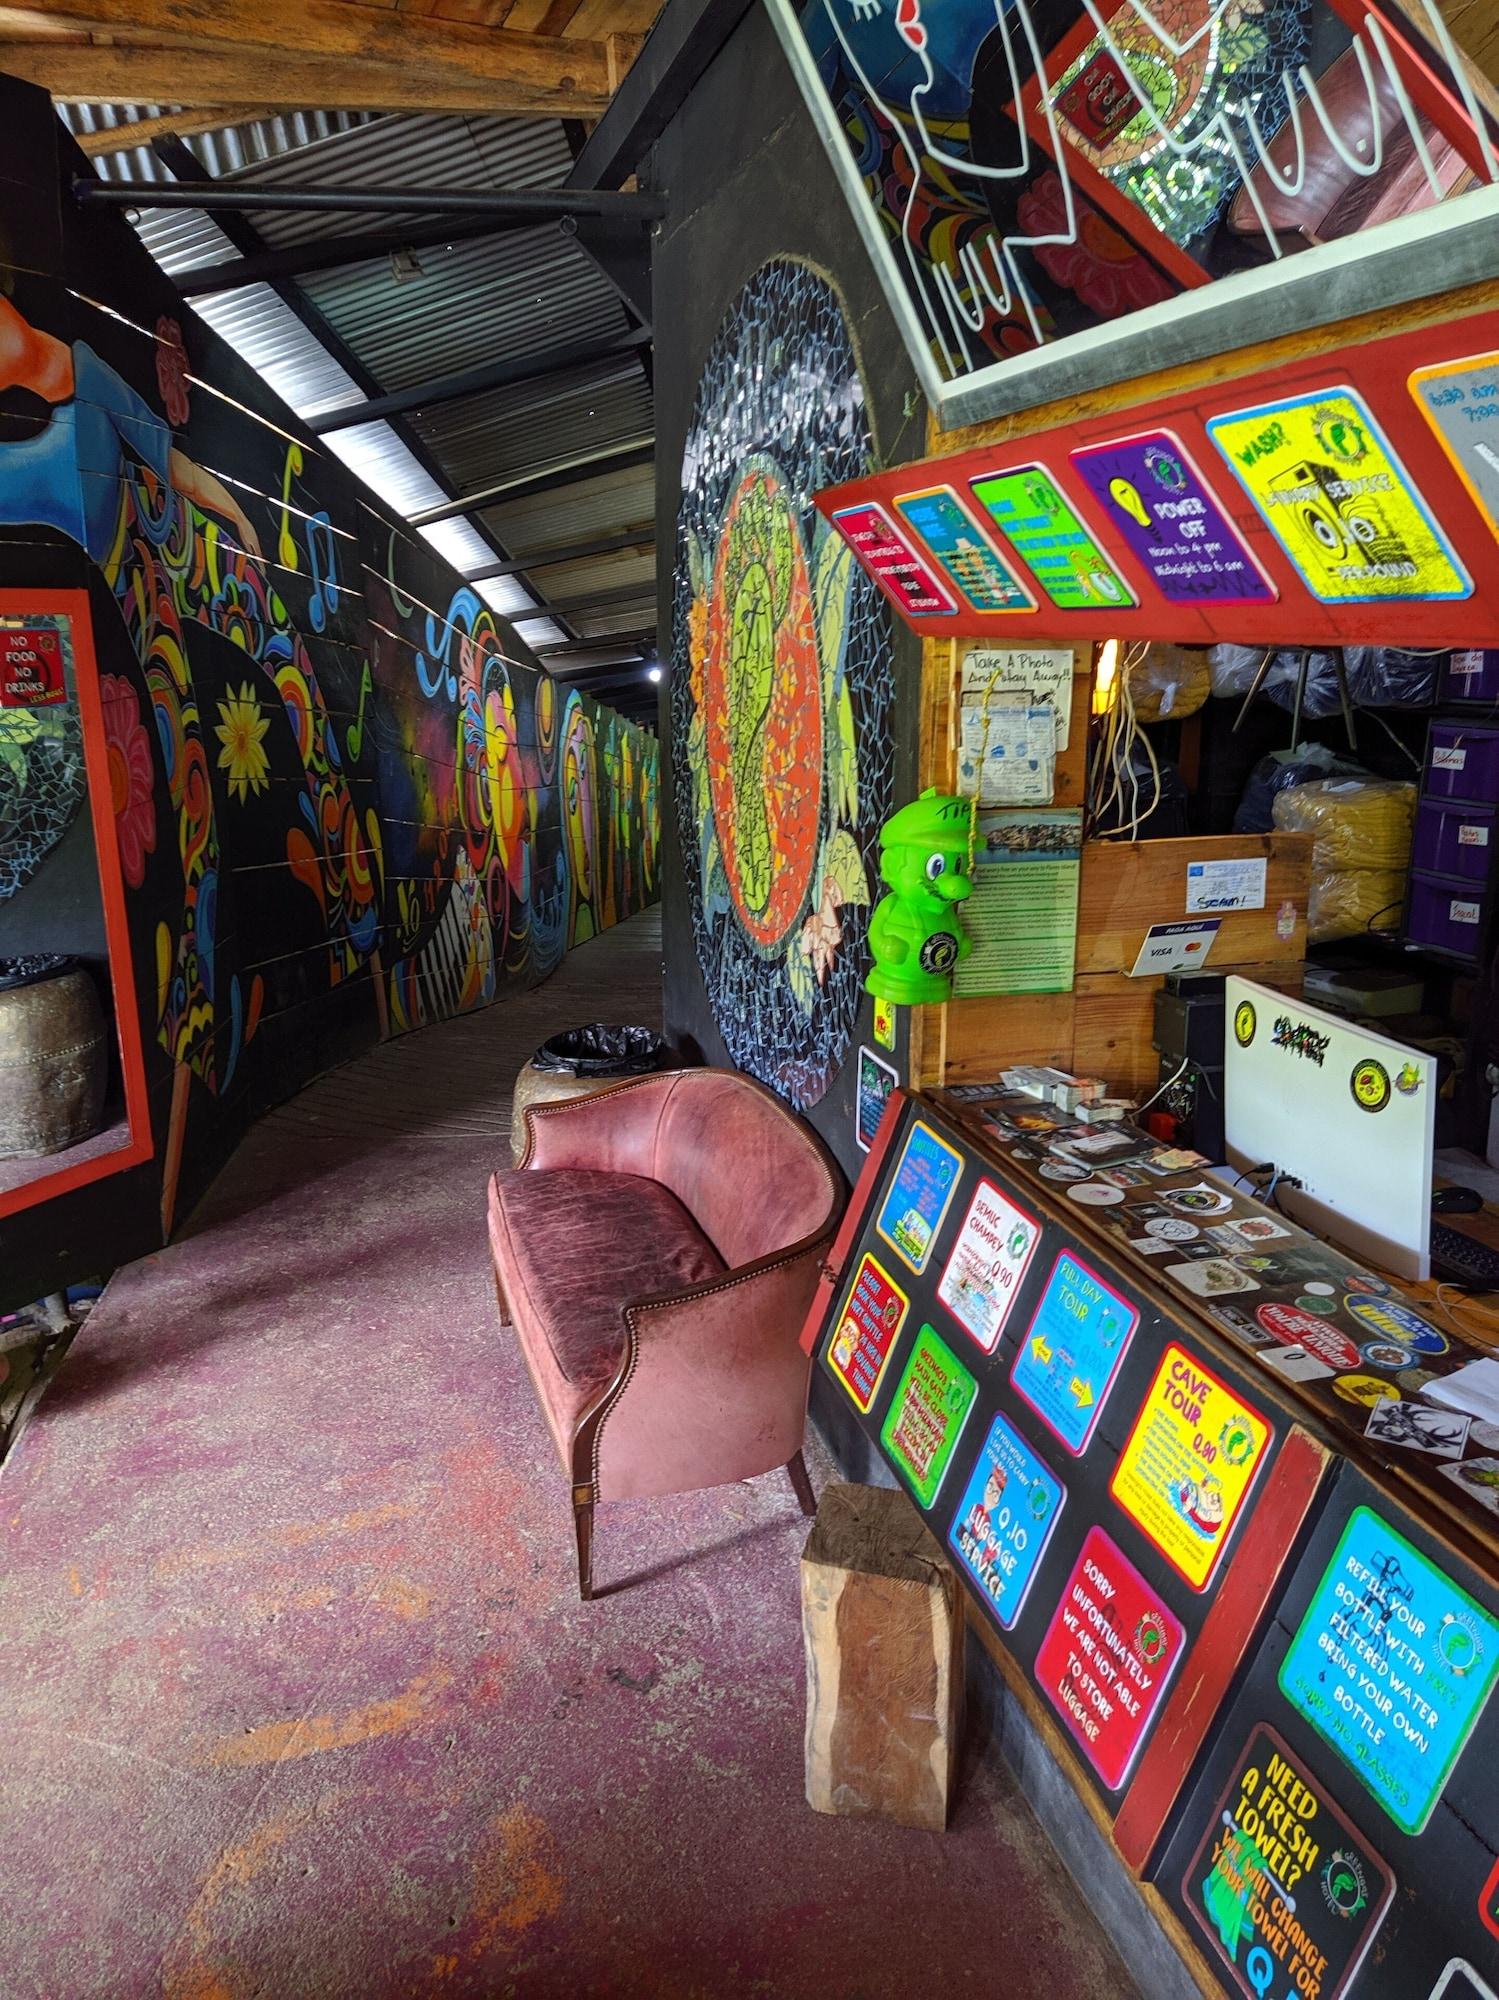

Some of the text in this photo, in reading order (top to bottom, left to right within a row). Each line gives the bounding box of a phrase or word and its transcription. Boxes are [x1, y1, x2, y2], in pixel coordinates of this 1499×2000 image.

[1236, 422, 1292, 467] WASH?
[1152, 496, 1208, 520] POWER
[1324, 474, 1395, 498] SERVICE
[1172, 542, 1193, 555] to
[1201, 541, 1229, 558] pm
[1175, 519, 1212, 538] OFF
[1194, 560, 1215, 573] to
[1365, 561, 1421, 578] POUND
[5, 651, 37, 662] FOOD
[10, 636, 28, 647] NO
[1007, 654, 1016, 668] A
[1017, 653, 1054, 669] Photo
[4, 682, 45, 693] DRINKS
[14, 667, 32, 678] NO
[1151, 947, 1173, 957] VISA
[968, 1214, 1004, 1256] CHAMPEY
[975, 1197, 1001, 1229] SEMUC
[1056, 1283, 1090, 1325] TOUR
[1059, 1260, 1103, 1308] FULL DAY
[928, 1377, 945, 1402] GATE
[1161, 1379, 1202, 1427] TOUR
[1169, 1357, 1211, 1405] CAVE
[999, 1431, 1012, 1450] YOU
[1009, 1443, 1027, 1468] WOULD
[1005, 1455, 1015, 1471] TO
[968, 1503, 1016, 1578] LUGGAGE
[959, 1529, 1005, 1604] SERVICE
[1082, 1557, 1115, 1604] SORRY
[1344, 1555, 1427, 1638] REFILL YOUR
[1061, 1606, 1140, 1719] WE ARE NOT ABLE
[1073, 1585, 1150, 1693] UNFORTUNATELY
[1334, 1582, 1460, 1710] BOTTLE WITH FREE
[1065, 1650, 1113, 1723] TO STORE
[1317, 1632, 1429, 1754] BRING YOUR OWN
[1329, 1612, 1439, 1729] FILTERED WATER
[1057, 1678, 1099, 1744] LUGGAGE
[1333, 1684, 1385, 1745] BOTTLE
[1294, 1673, 1410, 1808] SORRY NO GLASSES
[1265, 1753, 1319, 1826] NEED
[1240, 1763, 1319, 1871] A FRESH
[1232, 1796, 1302, 1893] TOWEL?
[1209, 1842, 1322, 2000] YOUR TOWEL FOR
[1219, 1826, 1328, 1979] WE WILL CHANGE
